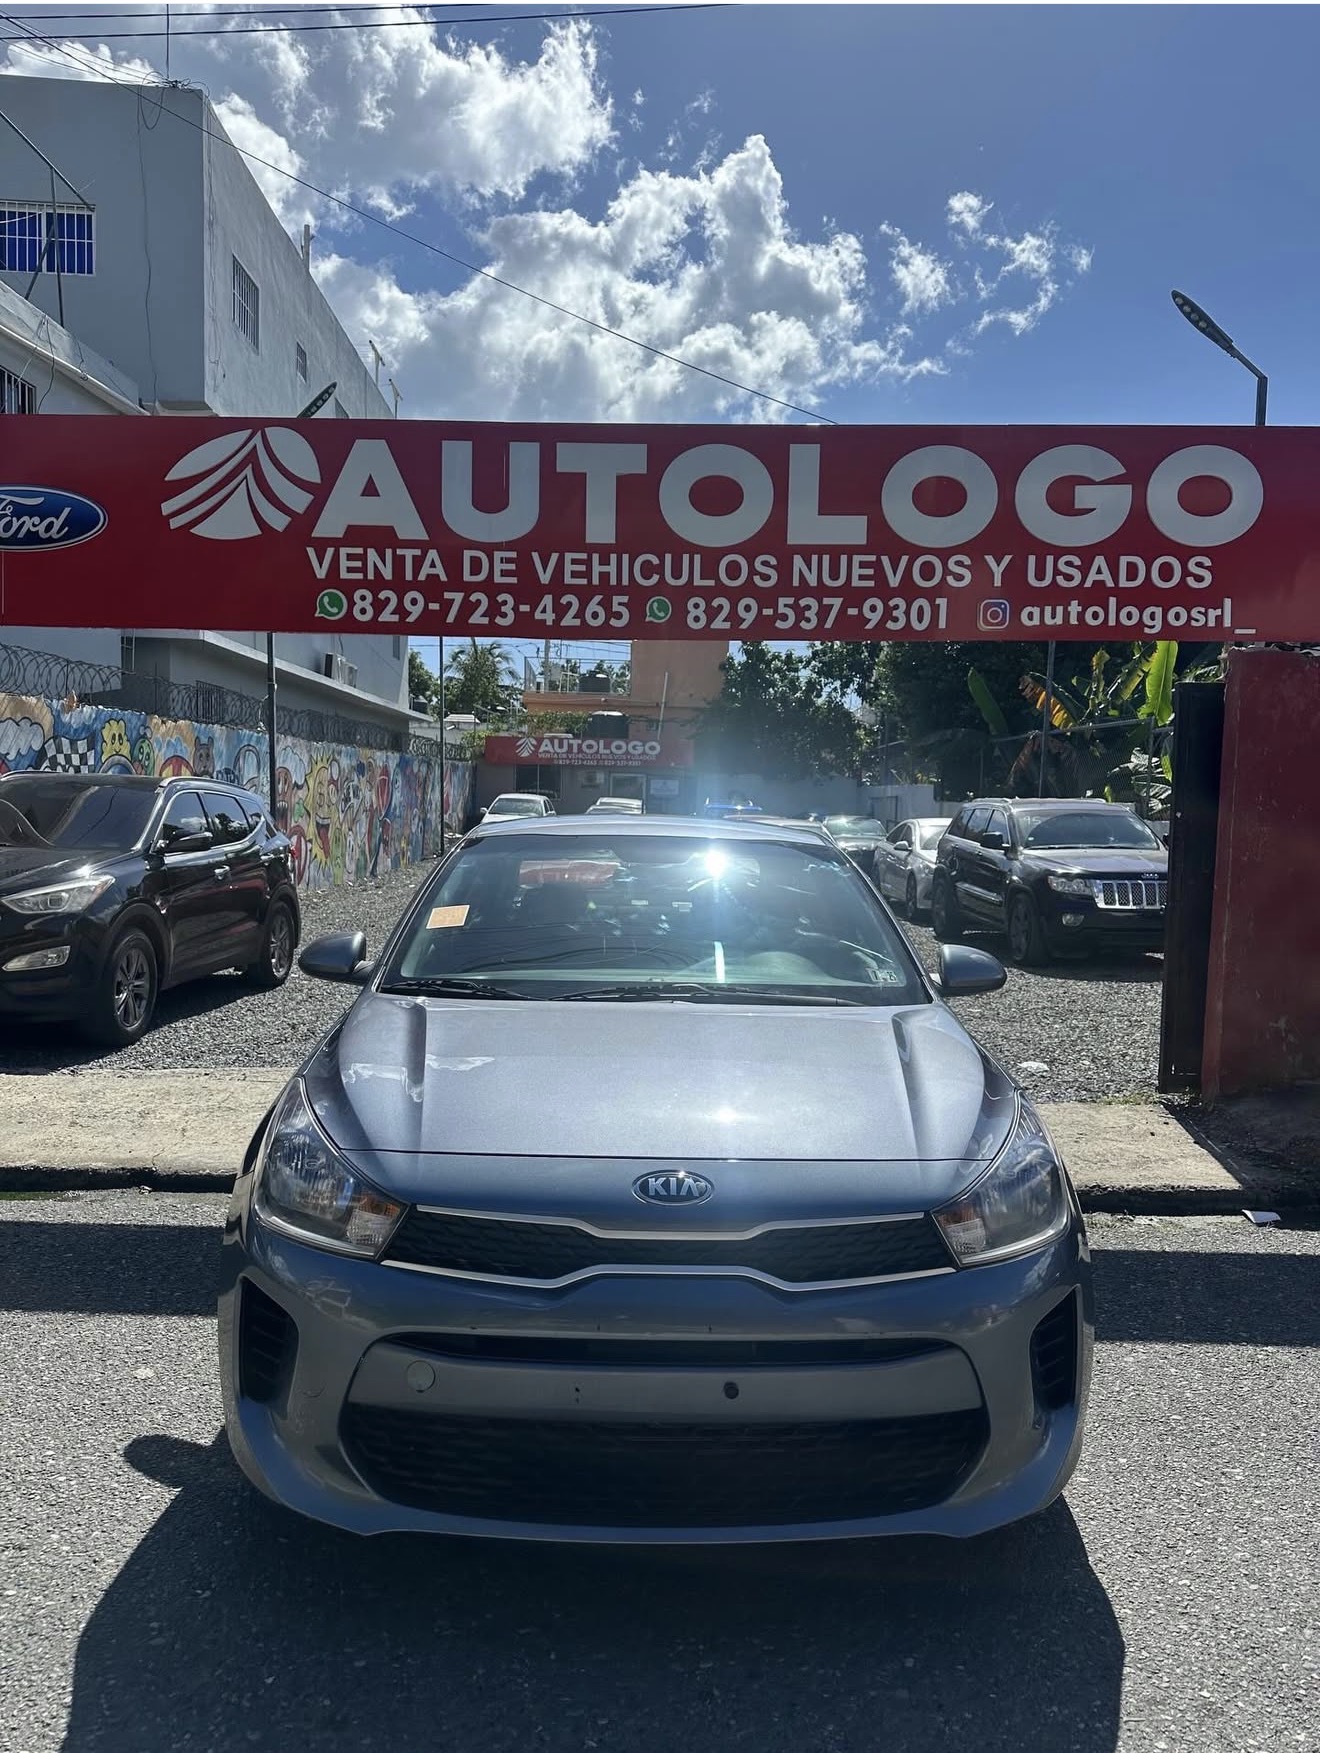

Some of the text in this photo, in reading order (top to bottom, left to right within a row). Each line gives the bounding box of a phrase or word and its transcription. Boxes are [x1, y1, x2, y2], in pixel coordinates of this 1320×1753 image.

[311, 439, 1264, 548] AUTOLOGO
[306, 546, 1213, 589] VENTA DE VEHICULOS NUEVOS Y USADOS
[352, 588, 631, 628] 829-723-4265
[686, 596, 949, 631] 829-537-9301
[1020, 596, 1257, 634] autologosrl_
[538, 738, 661, 755] AUTOLOGO
[648, 1177, 700, 1197] KIA
